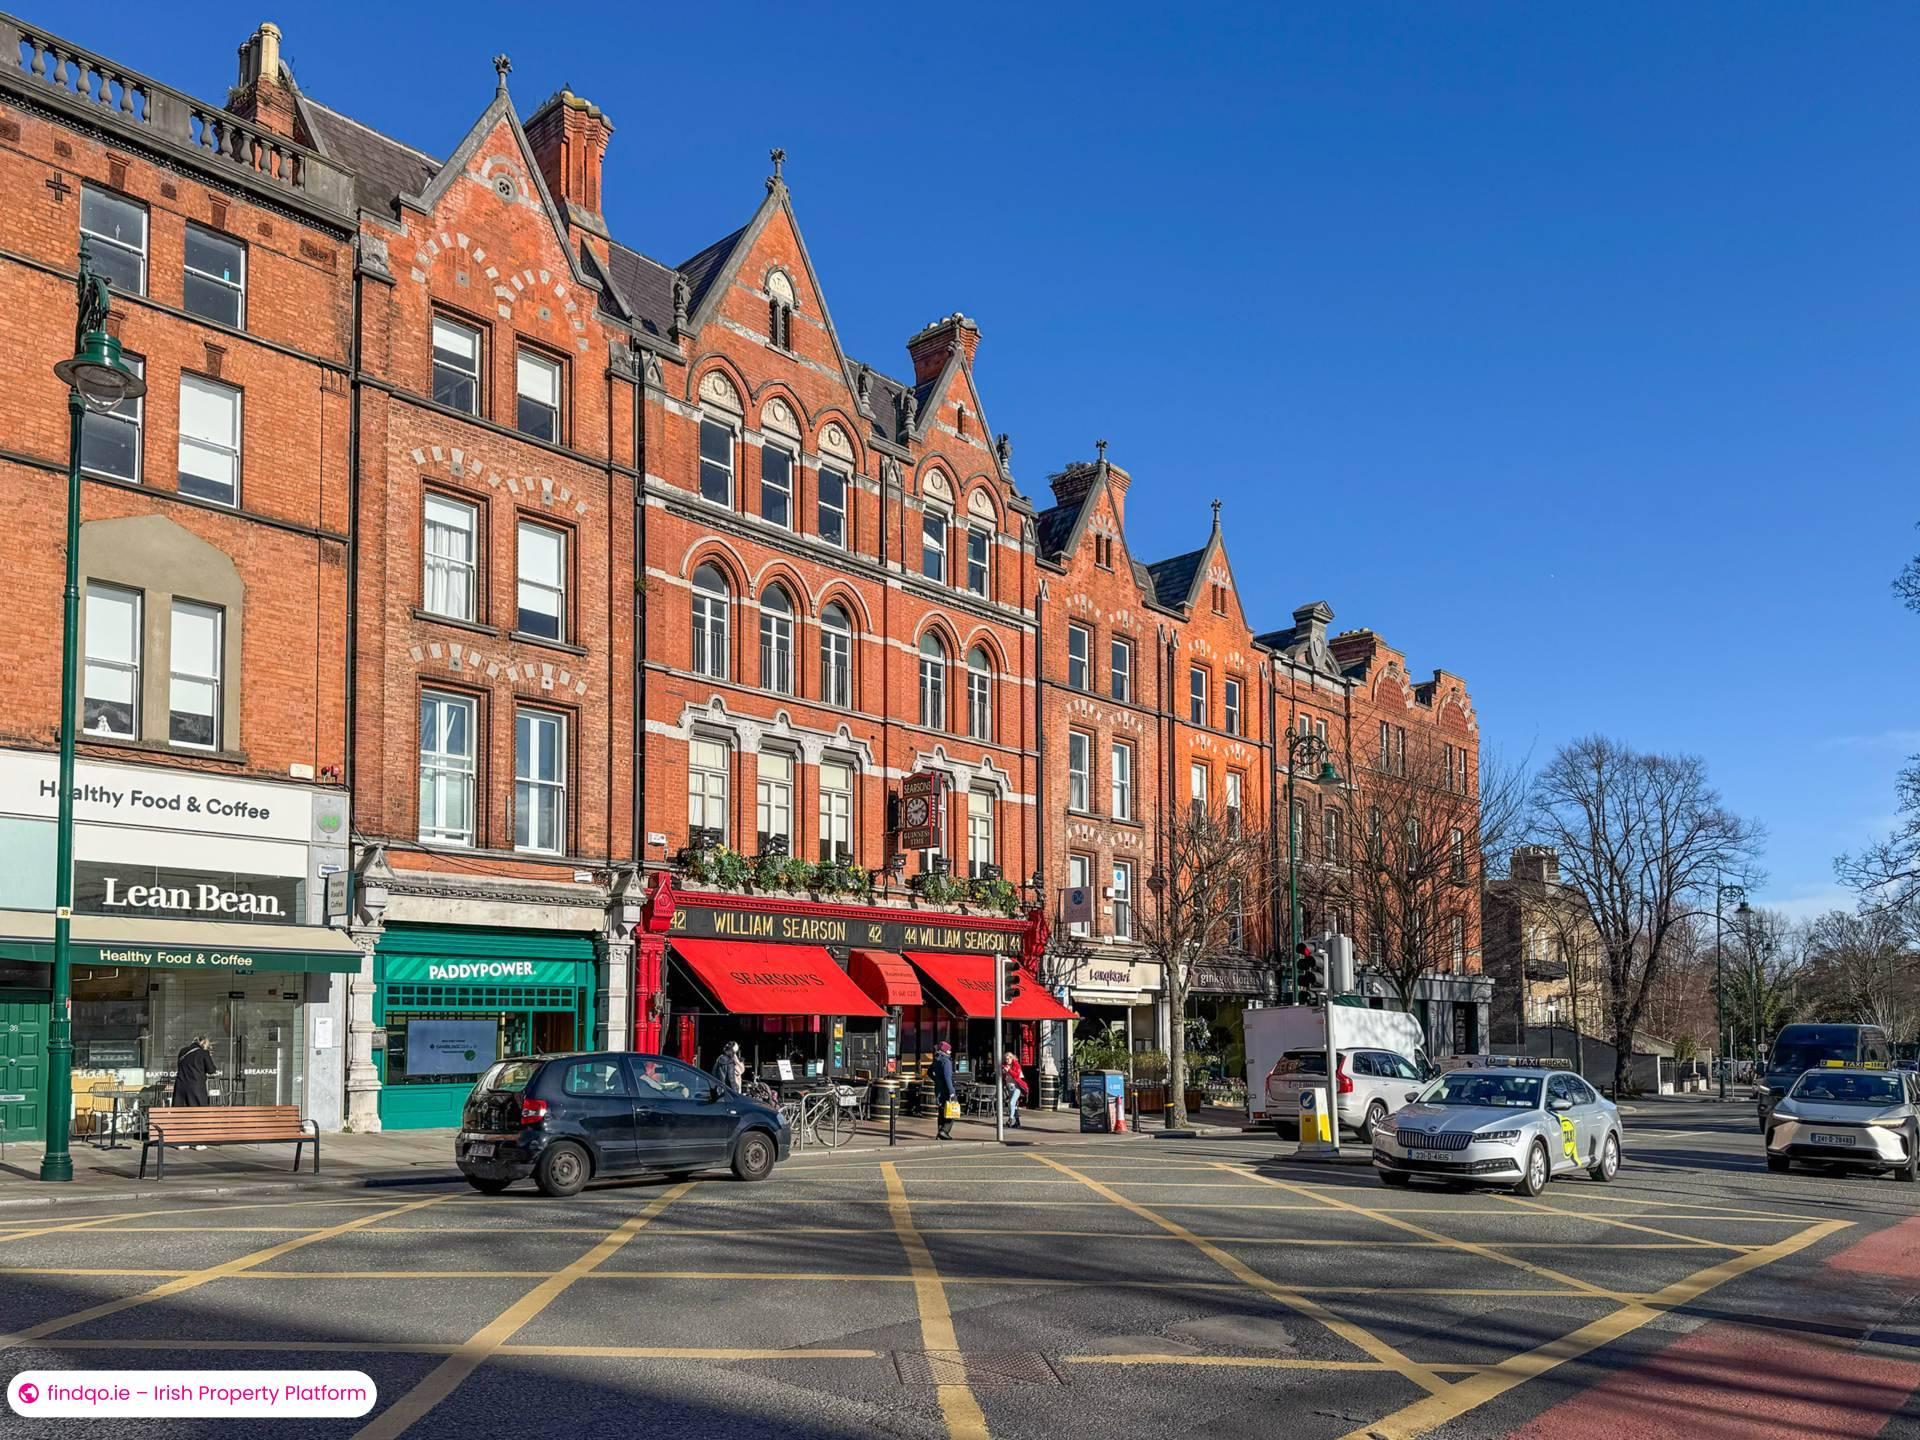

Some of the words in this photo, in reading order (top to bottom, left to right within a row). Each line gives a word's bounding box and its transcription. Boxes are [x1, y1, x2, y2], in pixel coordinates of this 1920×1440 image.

[40, 779, 124, 808] Halthy
[131, 789, 181, 811] Food
[186, 796, 201, 812] &
[206, 798, 270, 820] Coffee
[103, 877, 192, 910] Lean
[195, 884, 286, 917] Bean.
[670, 911, 686, 929] 42
[713, 912, 773, 937] WILLIAM
[783, 917, 846, 941] SEARSON
[868, 925, 881, 943] 42
[904, 928, 917, 944] 44
[919, 927, 960, 949] WILLIAM
[965, 931, 1008, 951] SEARSON
[1010, 936, 1020, 951] 44
[100, 950, 152, 964] Healthy
[157, 952, 191, 964] Food
[196, 953, 205, 965] &
[211, 954, 252, 966] Coffee
[1518, 1058, 1539, 1066] TAXI
[1563, 1130, 1575, 1143] TAXI
